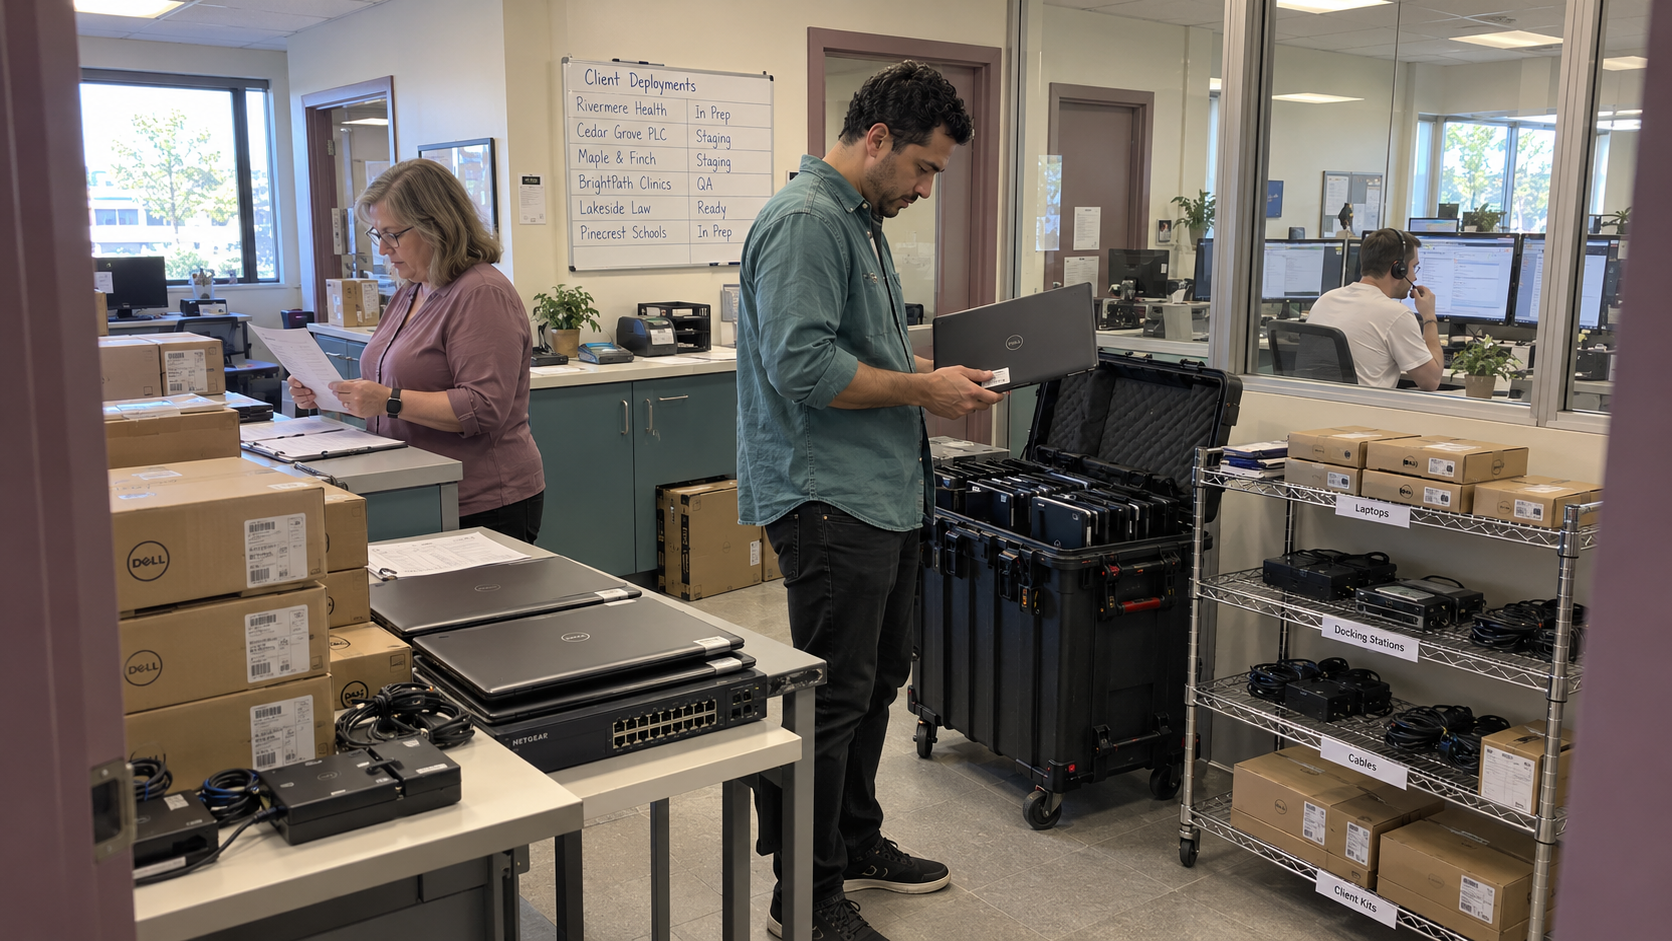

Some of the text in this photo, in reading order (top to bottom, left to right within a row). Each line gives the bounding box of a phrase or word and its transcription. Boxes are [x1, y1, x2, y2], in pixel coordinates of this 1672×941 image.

[584, 68, 697, 95] Client Deployments
[576, 95, 668, 116] Rivermere Health
[695, 104, 731, 126] In Prep
[576, 122, 668, 141] Cedar Grove PLC
[695, 128, 732, 150] Staging
[578, 148, 657, 169] Maple & Finch
[696, 152, 732, 174] Staging
[578, 173, 672, 195] BrightPath Clinics
[696, 176, 714, 191] QA
[580, 200, 651, 215] Lakeside Law
[697, 200, 727, 220] Ready
[580, 224, 667, 240] Pinecrest Schools
[697, 223, 733, 242] In Prep
[1355, 503, 1390, 519] Laptops
[132, 555, 166, 569] DELL
[1334, 624, 1406, 652] Docking Stations
[128, 662, 159, 675] DELL
[512, 732, 549, 747] NETGEAR
[1348, 753, 1378, 772] Cables
[1334, 885, 1378, 913] Client Kits
